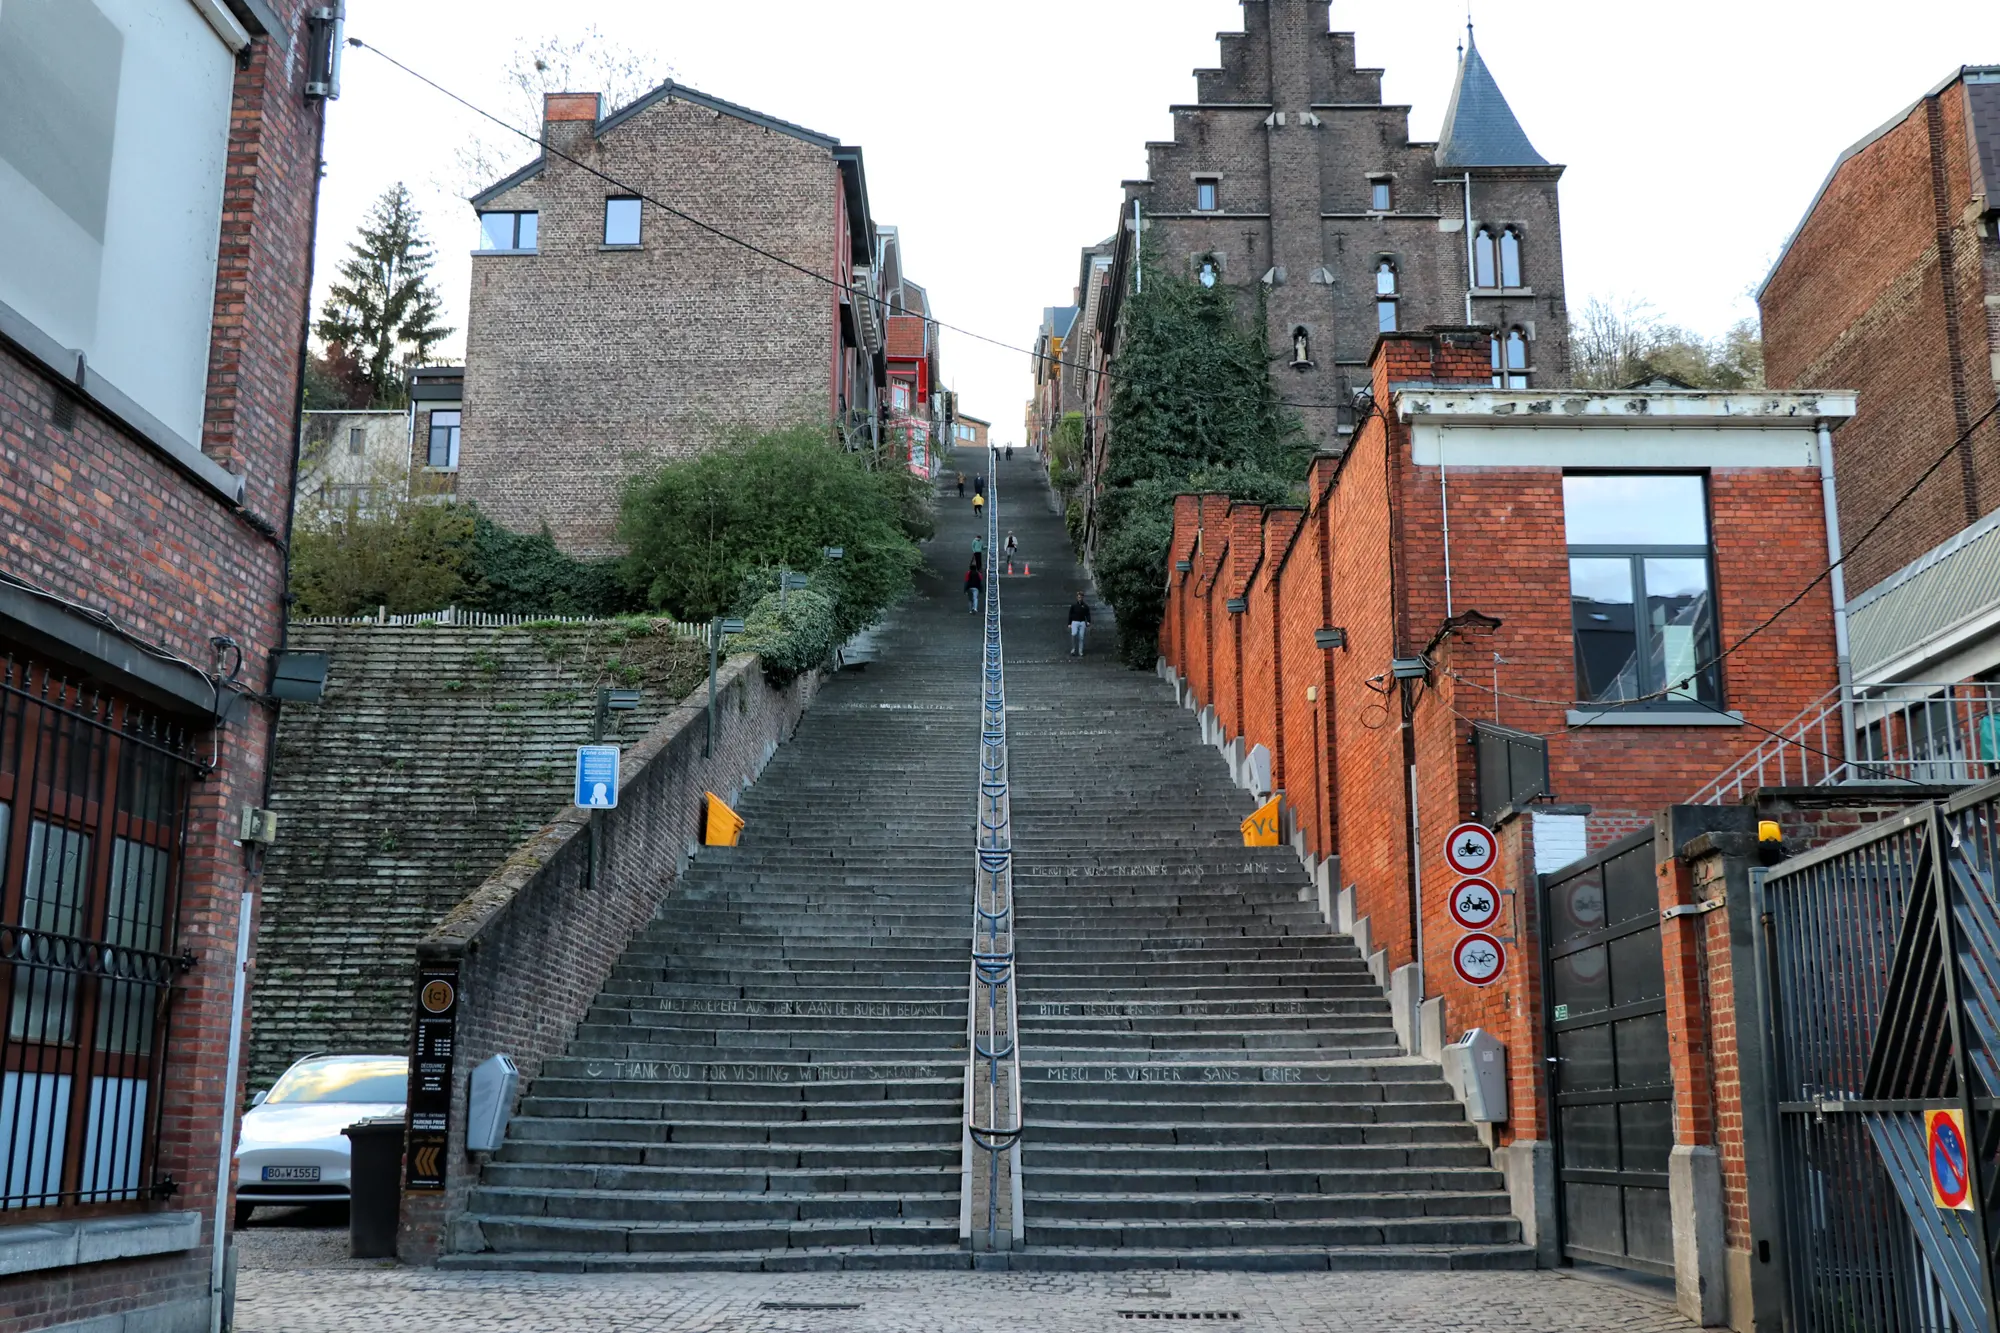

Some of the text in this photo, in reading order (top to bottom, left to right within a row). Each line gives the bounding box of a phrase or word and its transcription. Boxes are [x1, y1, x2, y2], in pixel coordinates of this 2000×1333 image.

[659, 998, 687, 1012] NIET
[692, 999, 737, 1013] ROEPEN
[807, 1001, 832, 1015] AAN
[835, 1002, 849, 1016] DE
[853, 1002, 891, 1017] BUREN
[896, 1003, 947, 1017] BEDANKT
[1039, 1002, 1071, 1016] BITTE
[1224, 1002, 1241, 1015] ZU
[613, 1061, 658, 1080] THANK
[664, 1062, 690, 1079] YOU
[701, 1063, 727, 1081] FOR
[732, 1063, 789, 1082] VISITING
[1047, 1066, 1302, 1082] MERCI DE VISITER SANS CRIER
